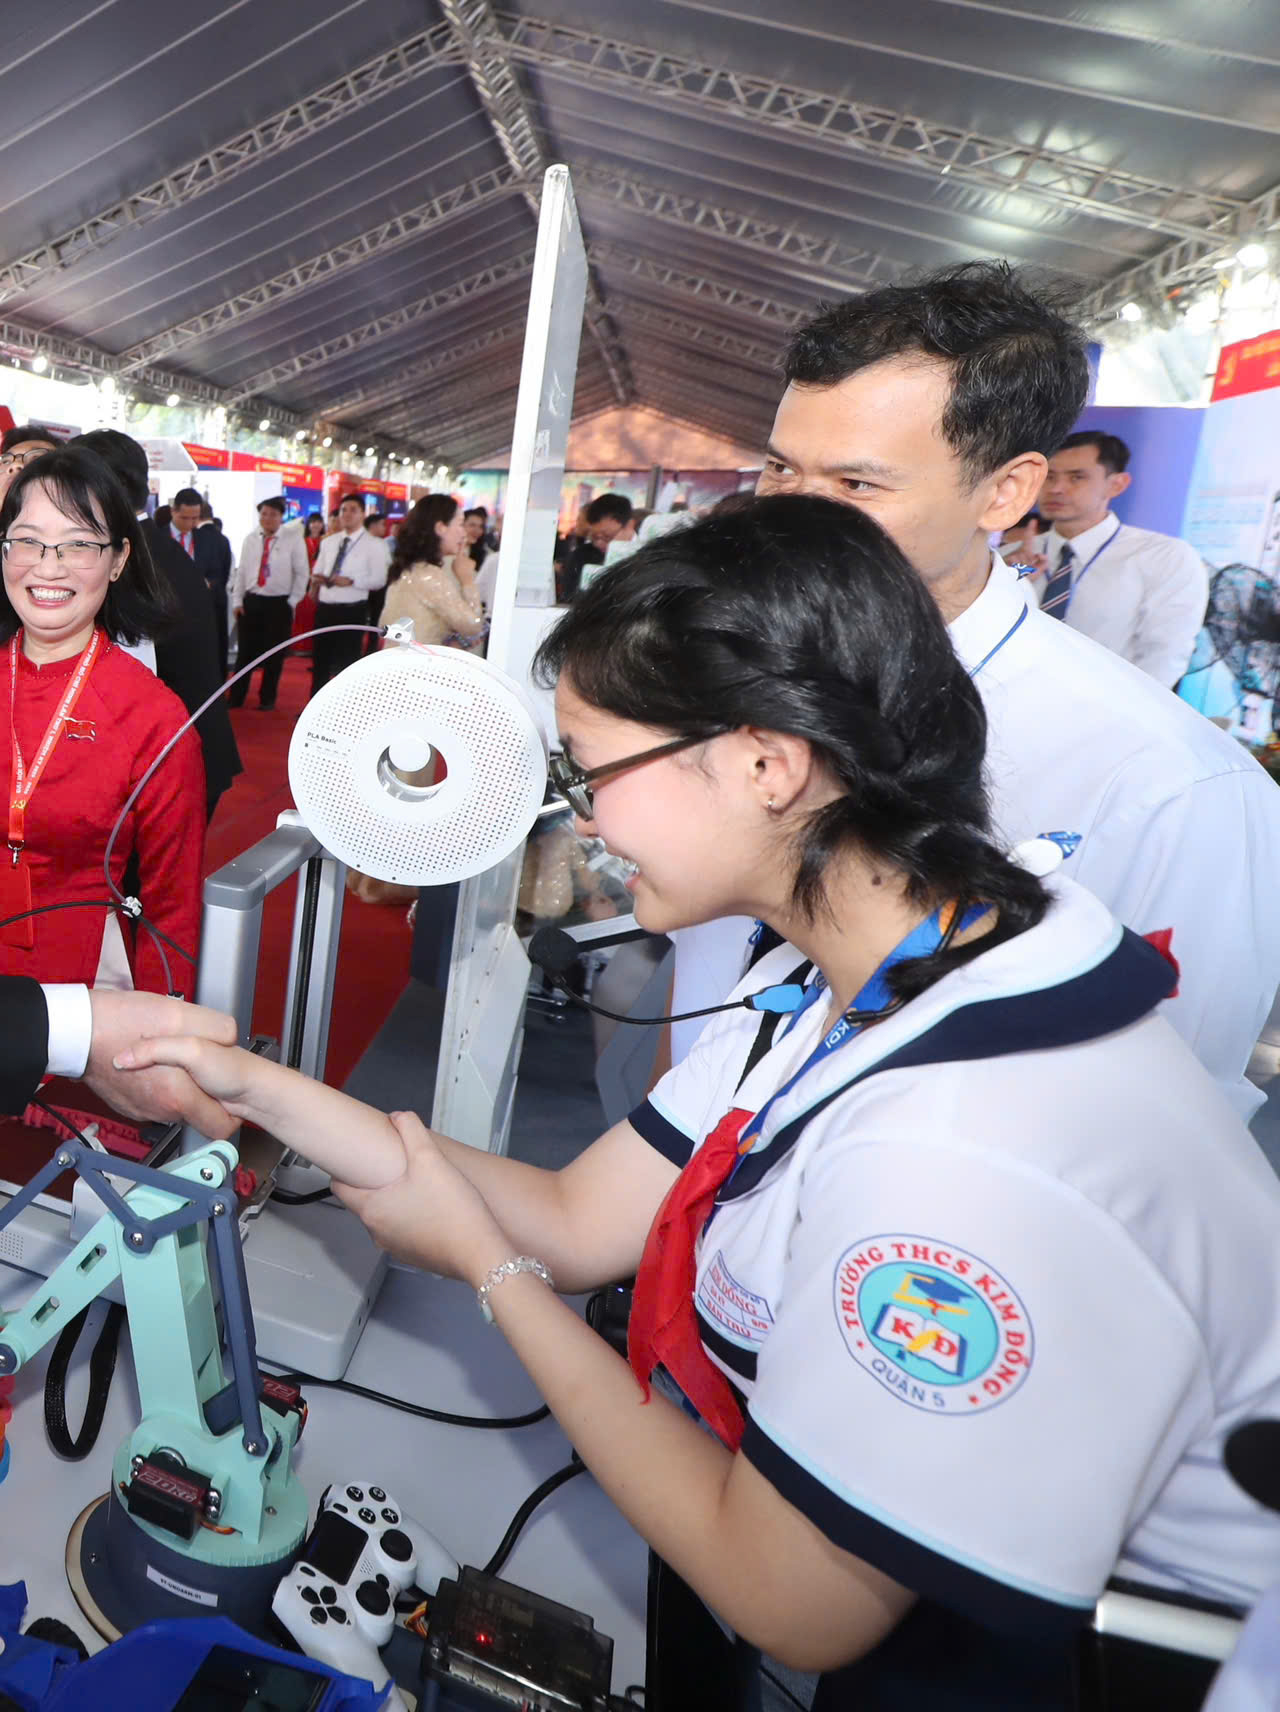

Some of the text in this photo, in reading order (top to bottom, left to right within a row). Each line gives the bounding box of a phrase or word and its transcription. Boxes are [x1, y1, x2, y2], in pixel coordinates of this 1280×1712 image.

[321, 736, 337, 744] Basic
[840, 1246, 885, 1330] TRƯỜNG
[891, 1243, 972, 1276] THCS
[975, 1274, 1020, 1323] KIM
[891, 1316, 915, 1340] K
[933, 1391, 945, 1407] 5
